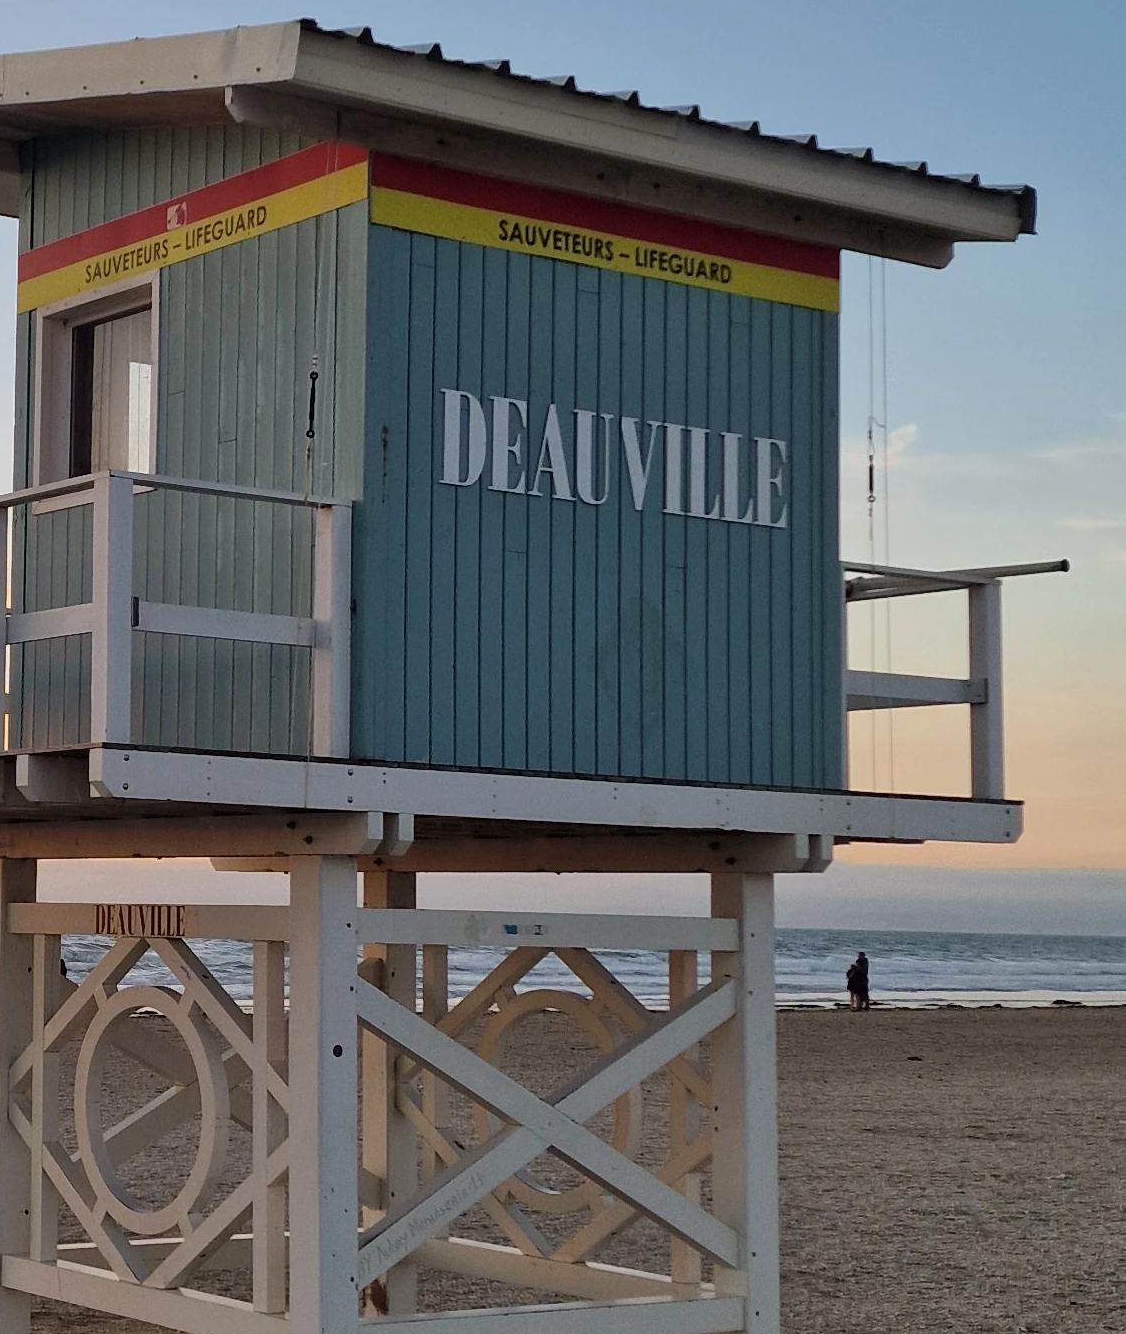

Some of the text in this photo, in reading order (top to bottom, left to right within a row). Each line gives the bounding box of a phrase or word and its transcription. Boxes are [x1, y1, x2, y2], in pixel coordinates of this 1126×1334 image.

[85, 239, 169, 283] SAUVETEURS
[185, 205, 267, 250] LIFEGUARD
[498, 219, 614, 261] SAUVETEURS
[635, 247, 732, 284] LIFEGUARD
[438, 388, 788, 529] DEAUVILLE
[94, 904, 186, 937] DEAUVILLE
